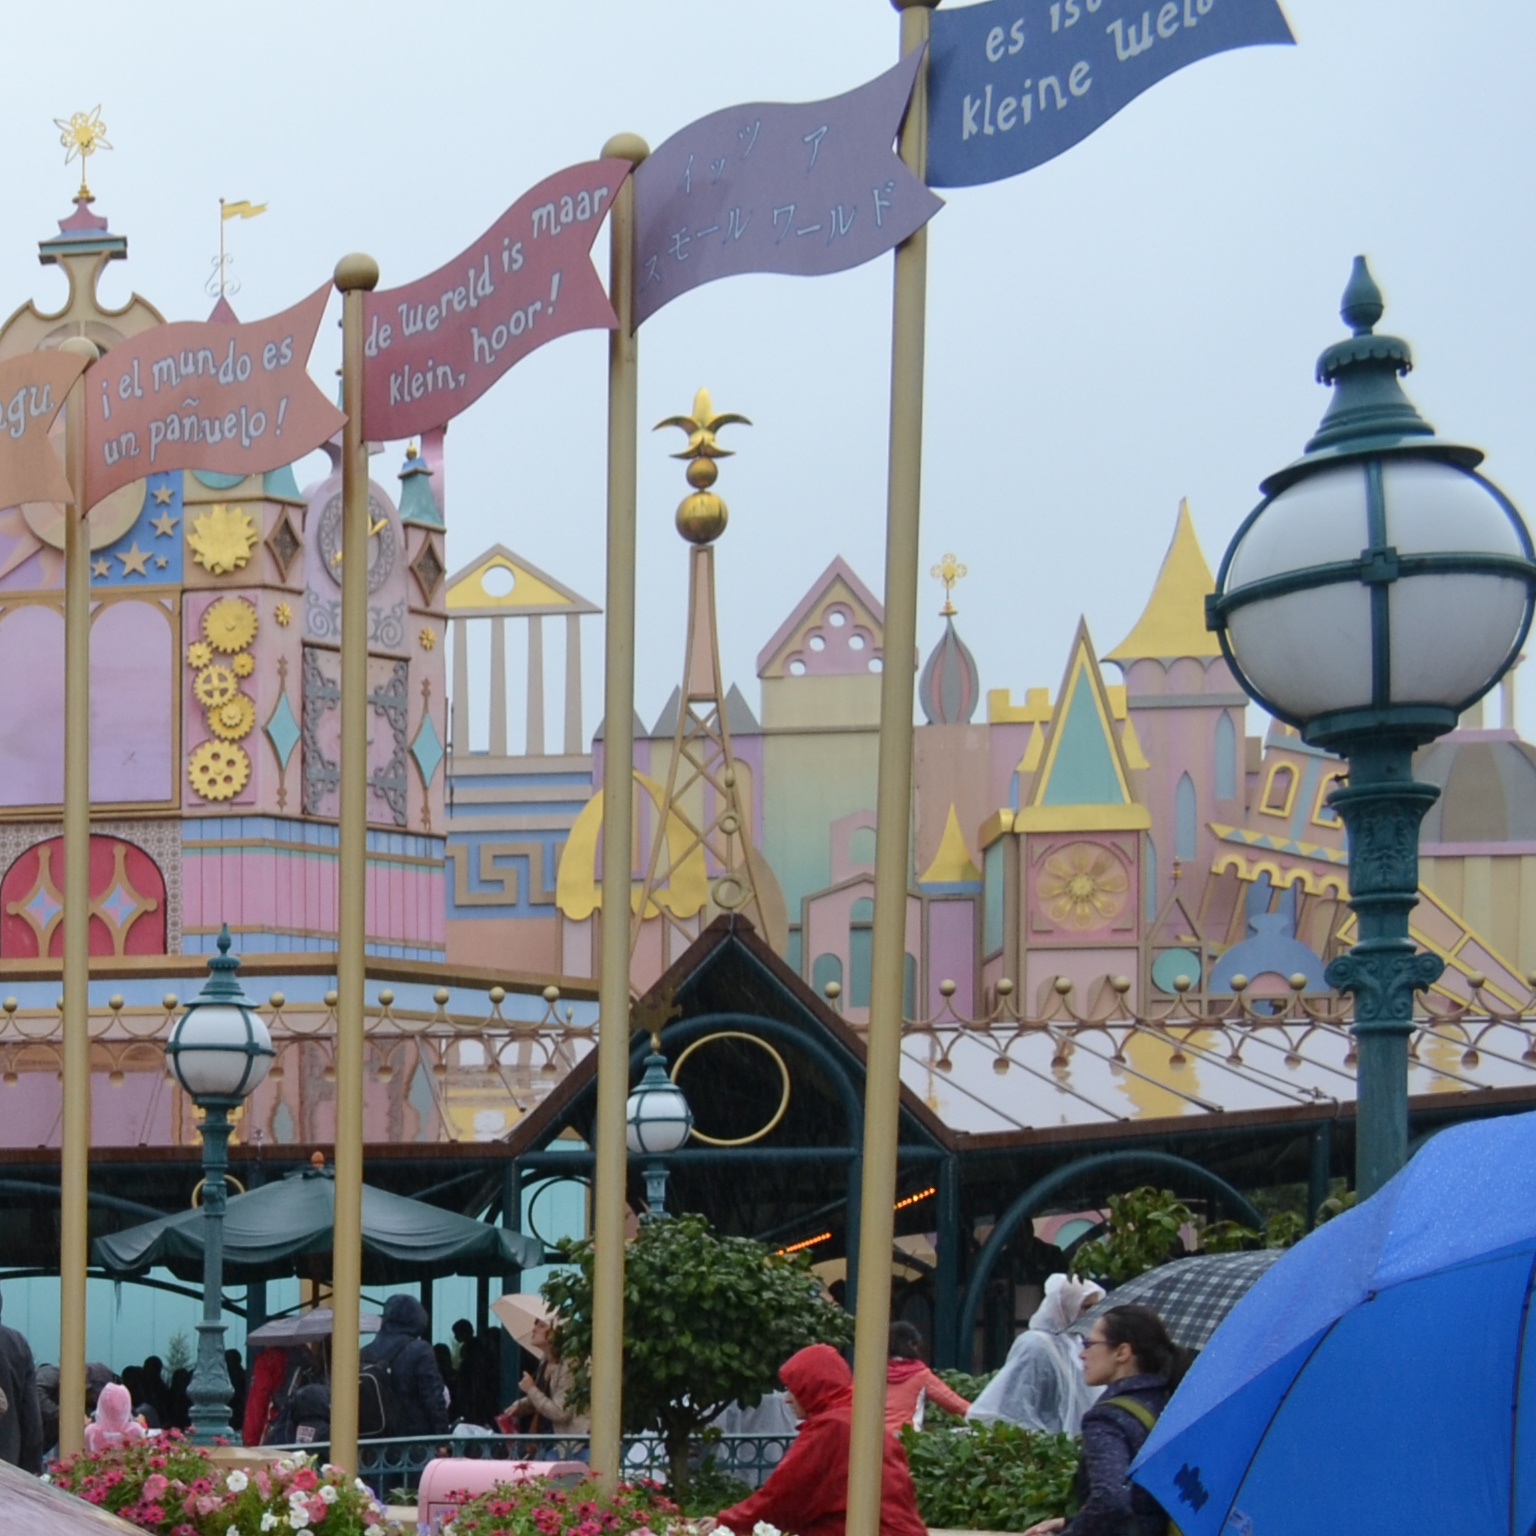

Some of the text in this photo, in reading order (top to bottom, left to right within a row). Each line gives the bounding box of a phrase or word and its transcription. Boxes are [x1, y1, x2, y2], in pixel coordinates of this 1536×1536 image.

[985, 17, 1026, 63] es
[364, 314, 391, 358] de
[502, 236, 524, 274] is
[531, 186, 609, 239] maar
[152, 337, 252, 393] mundo
[263, 334, 294, 371] es
[104, 430, 141, 466] un
